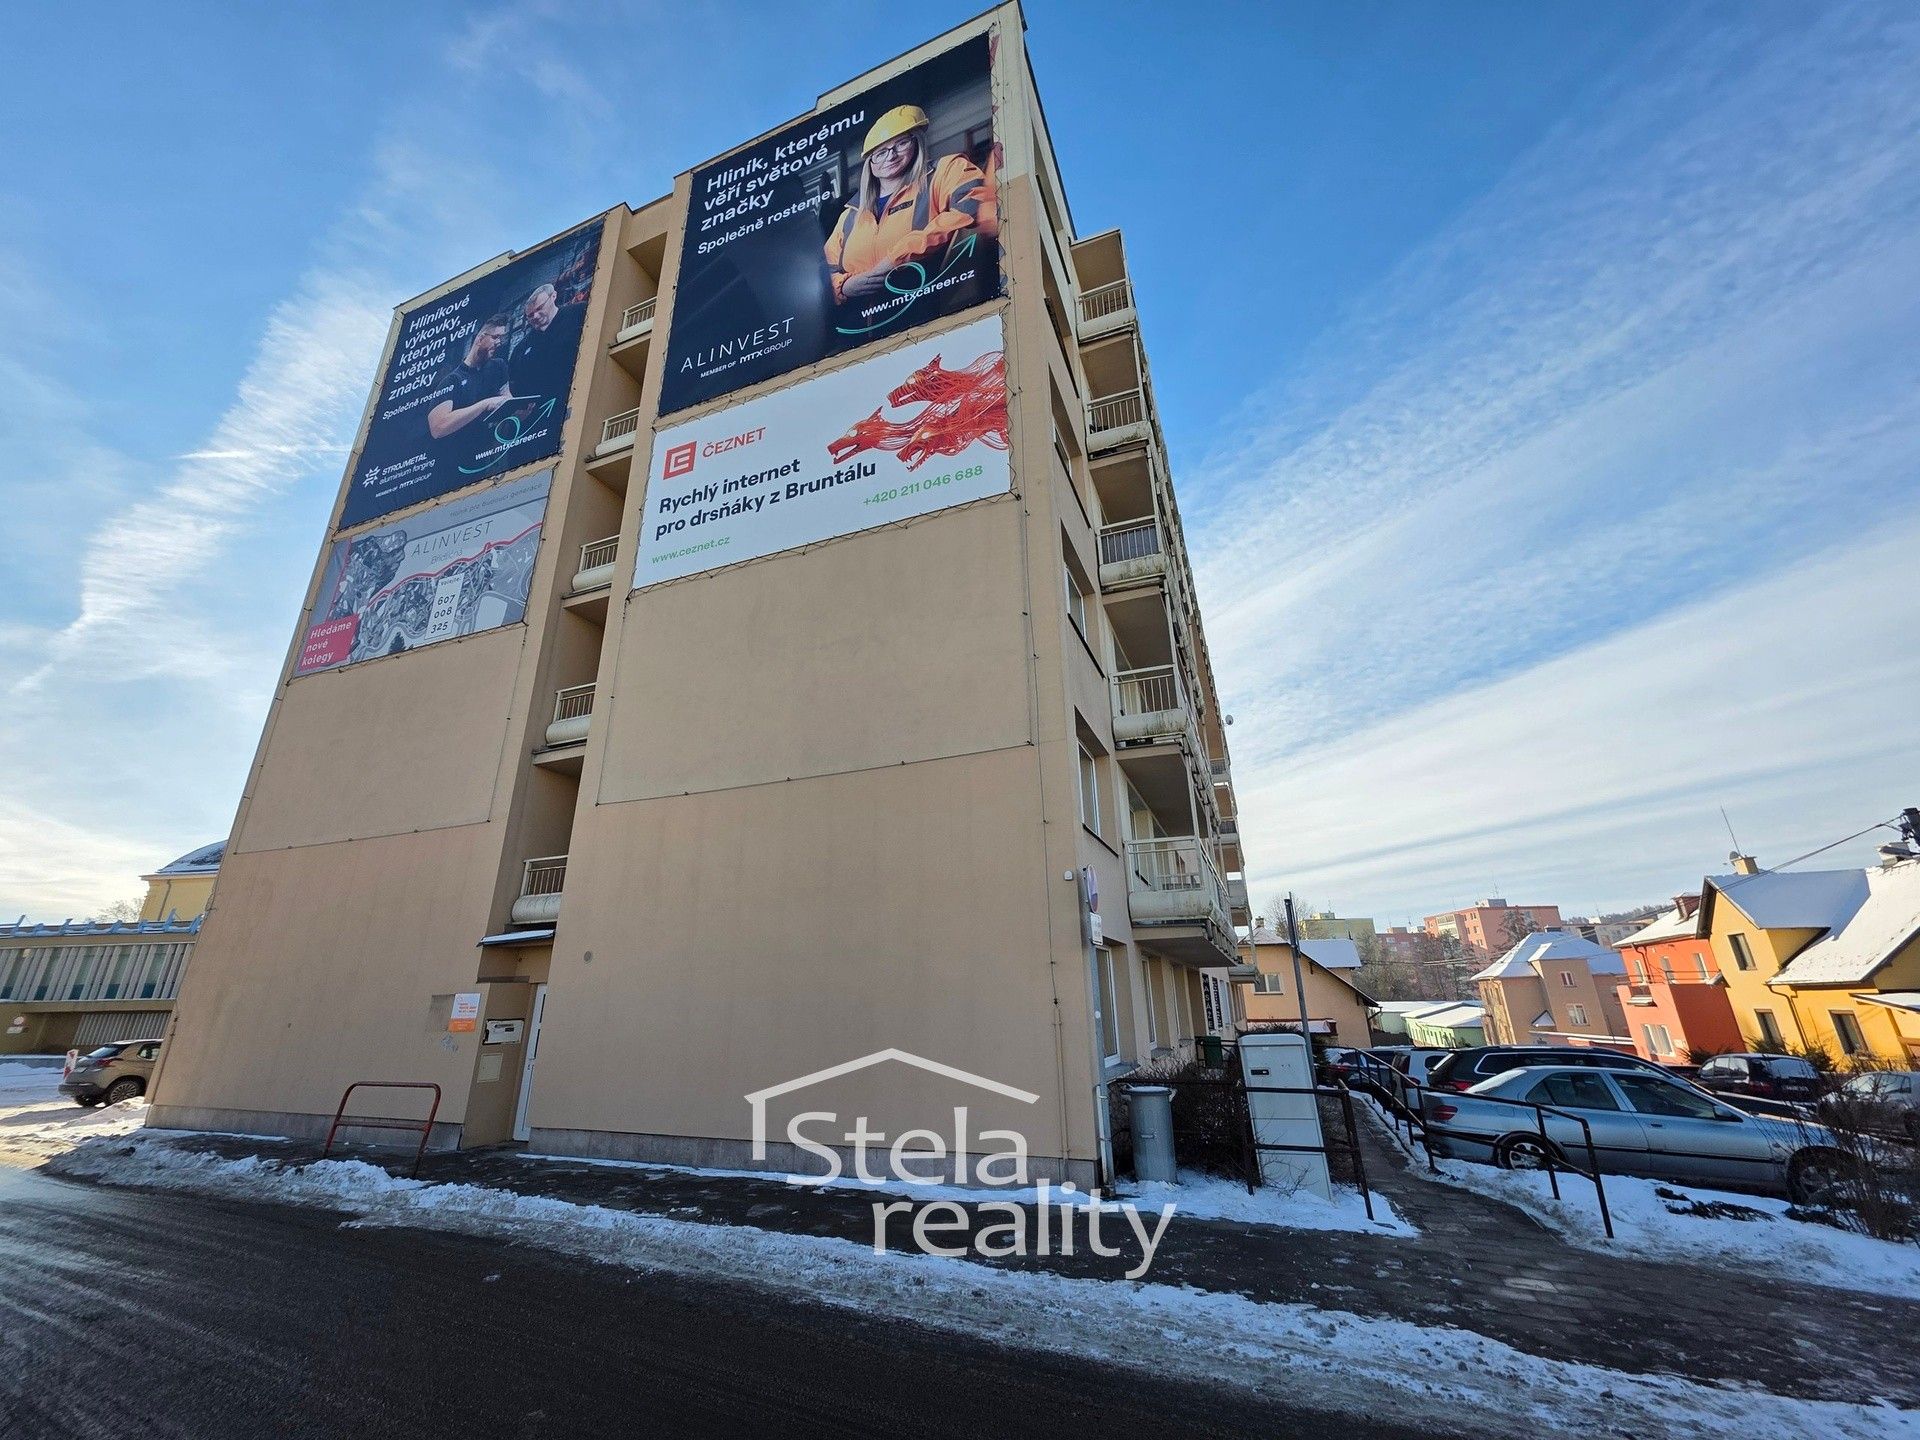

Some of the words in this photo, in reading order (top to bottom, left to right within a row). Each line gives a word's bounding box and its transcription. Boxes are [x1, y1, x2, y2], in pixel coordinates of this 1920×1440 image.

[707, 157, 769, 194] Hliník,
[774, 110, 865, 161] kterému
[703, 182, 742, 211] věří
[746, 144, 829, 193] světové
[698, 219, 764, 254] Společně
[767, 190, 830, 222] rosteme
[701, 189, 774, 231] značky
[861, 267, 975, 318] www.mtxcareer.cz
[409, 294, 470, 333] Hliníkové
[399, 336, 447, 367] kterým
[450, 320, 476, 344] věří
[405, 316, 461, 350] výkovky,
[681, 317, 794, 373] ALINVEST
[388, 371, 437, 401] značky
[394, 351, 446, 383] světové
[700, 363, 727, 379] MEMBER
[382, 397, 420, 420] Společně
[419, 384, 455, 405] rosteme
[475, 428, 548, 461] www.mtxcareer.cz
[702, 426, 766, 459] ČEZNET
[655, 514, 686, 541] pro
[690, 492, 765, 528] drsňáky
[785, 460, 876, 501] Bruntálu
[659, 480, 719, 514] Rychlý
[722, 457, 801, 496] internet
[863, 486, 898, 507] +420
[900, 482, 920, 497] 211
[922, 473, 952, 492] 046
[954, 464, 984, 486] 688
[412, 520, 494, 558] ALINVEST
[651, 536, 730, 564] www.ceznet.cz
[305, 638, 328, 652] nové
[310, 621, 352, 640] Hledáme
[301, 651, 334, 669] kolegy
